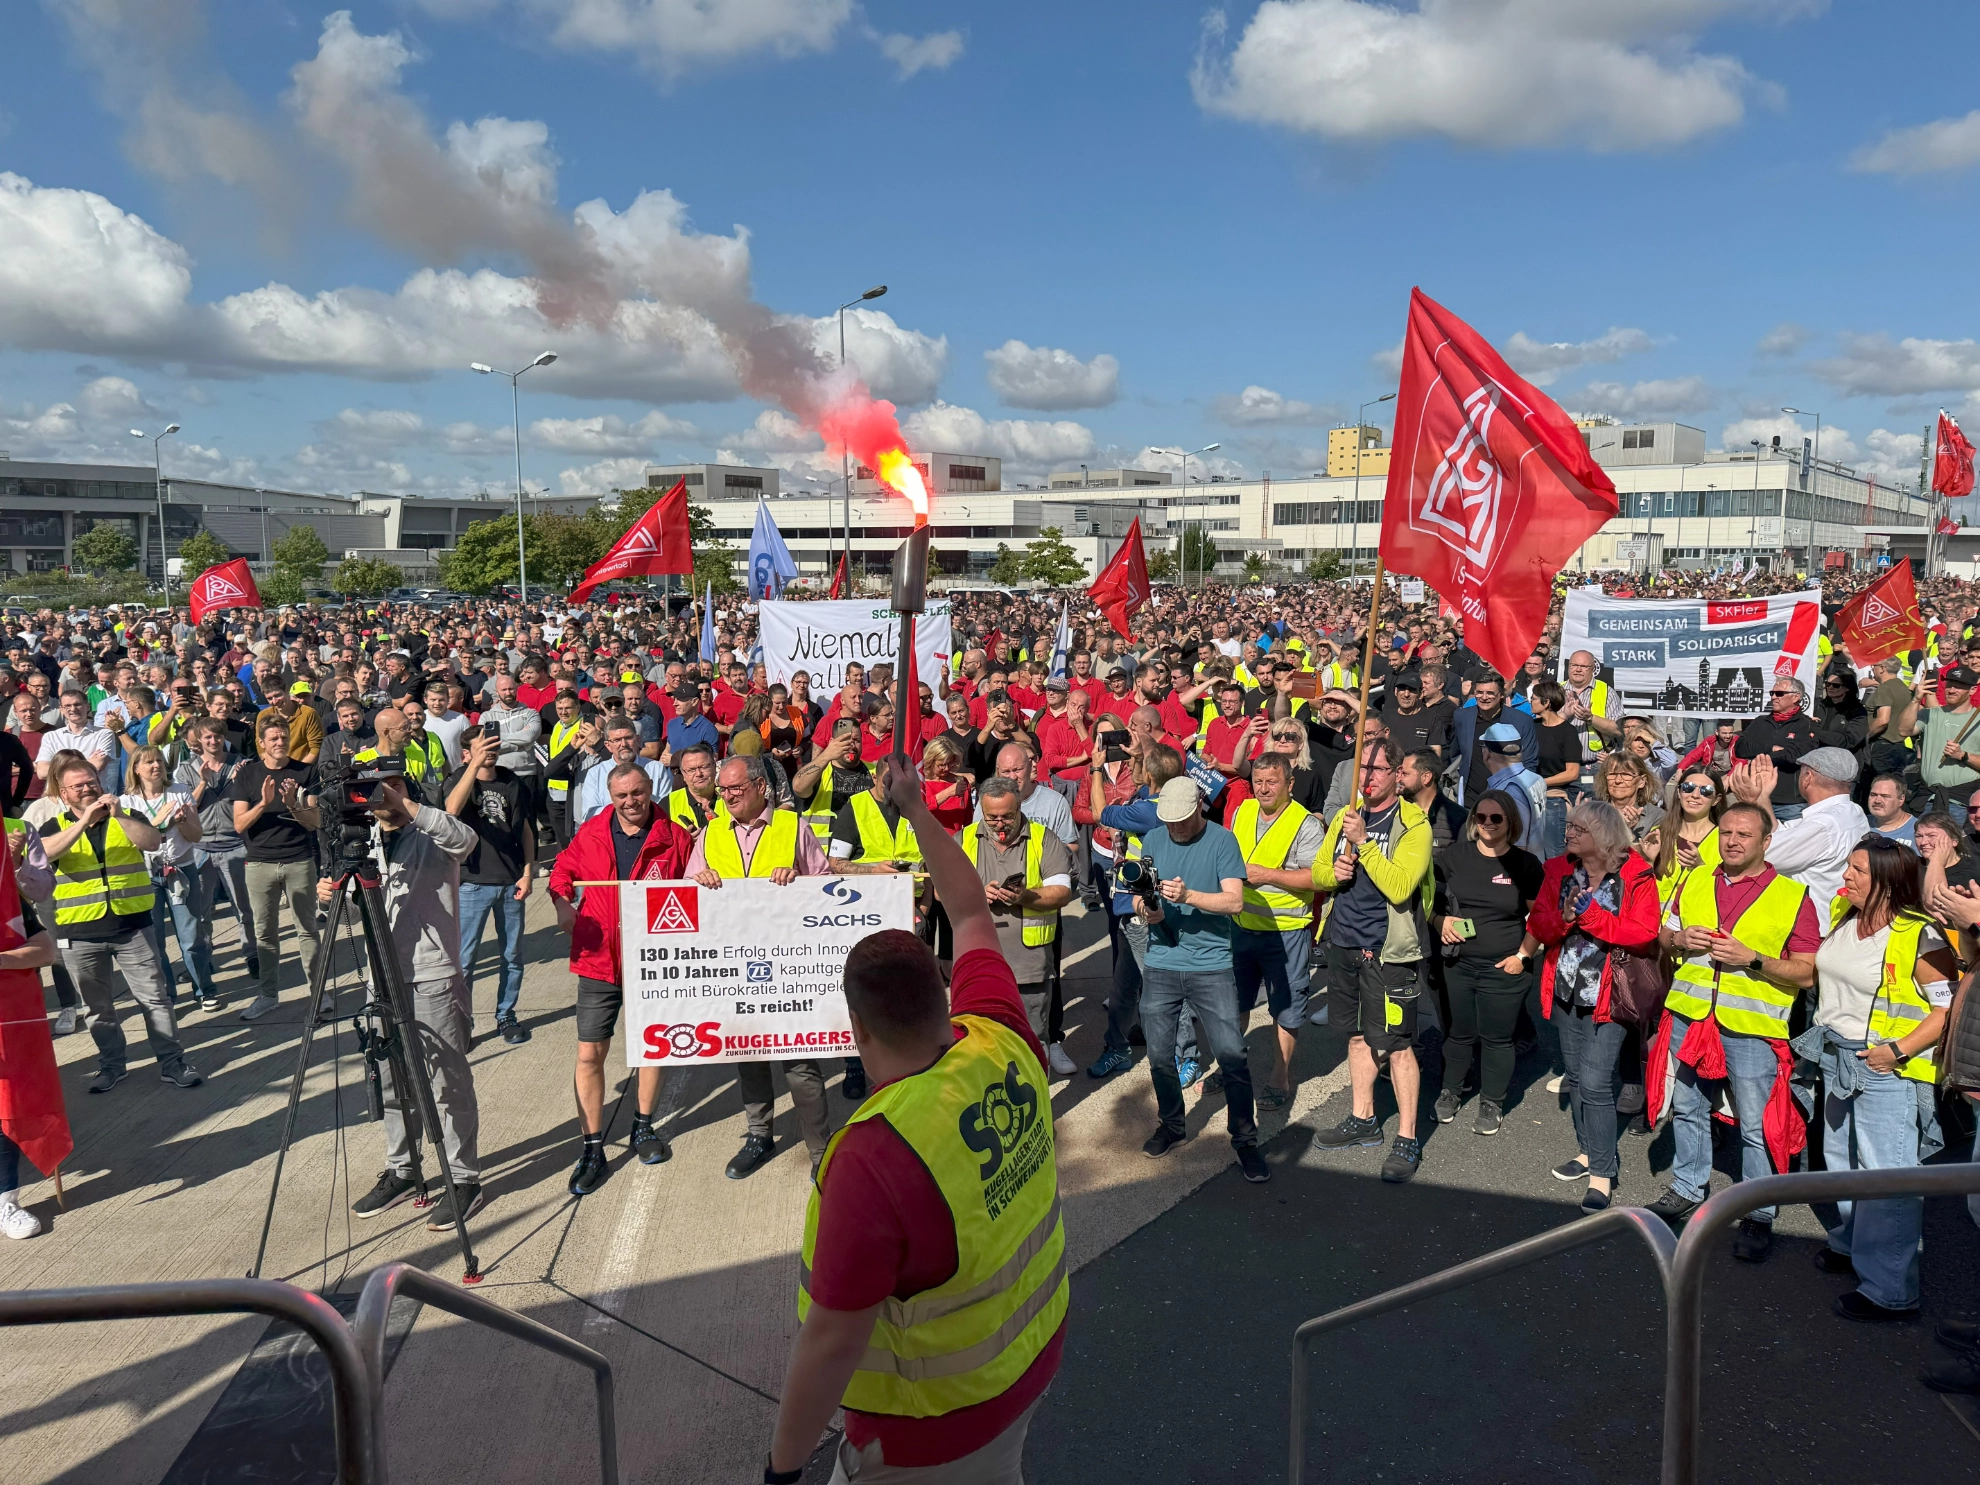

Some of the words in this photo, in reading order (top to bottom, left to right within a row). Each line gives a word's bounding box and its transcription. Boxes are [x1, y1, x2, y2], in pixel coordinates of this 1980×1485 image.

[1716, 604, 1760, 618] SKFler
[1599, 617, 1689, 631] GEMEINSAM
[788, 623, 902, 662] Niemal
[1677, 631, 1779, 652] SOLIDARISCH
[1611, 648, 1657, 662] STARK
[1547, 667, 1555, 675] 14
[1187, 752, 1201, 764] Nur
[1211, 770, 1225, 783] uns
[1190, 766, 1213, 784] geht's
[802, 914, 882, 928] SACHS
[640, 948, 668, 961] 130
[673, 946, 718, 961] Jahre
[723, 945, 766, 960] Erfolg
[771, 944, 812, 957] durch
[818, 943, 855, 956] Innov
[641, 967, 657, 981] In
[662, 966, 680, 980] 10
[684, 964, 739, 979] Jahren
[748, 963, 771, 981] ZF
[780, 962, 844, 978] kaputtge
[641, 987, 669, 1000] und
[675, 985, 698, 998] mit
[702, 983, 778, 998] Bürokratie
[782, 979, 846, 996] lahmgele
[1935, 990, 1951, 998] ORD
[735, 1001, 755, 1015] Es
[760, 999, 814, 1014] reicht!
[643, 1021, 723, 1060] SOS
[724, 1030, 854, 1050] KUGELLAGERS
[725, 1049, 757, 1057] ZUKUNFT
[958, 1060, 1038, 1181] SOS
[984, 1116, 1045, 1200] KUGELLAGERSTADT
[987, 1202, 1002, 1222] IN
[999, 1136, 1053, 1210] SCHWEINFURT!
